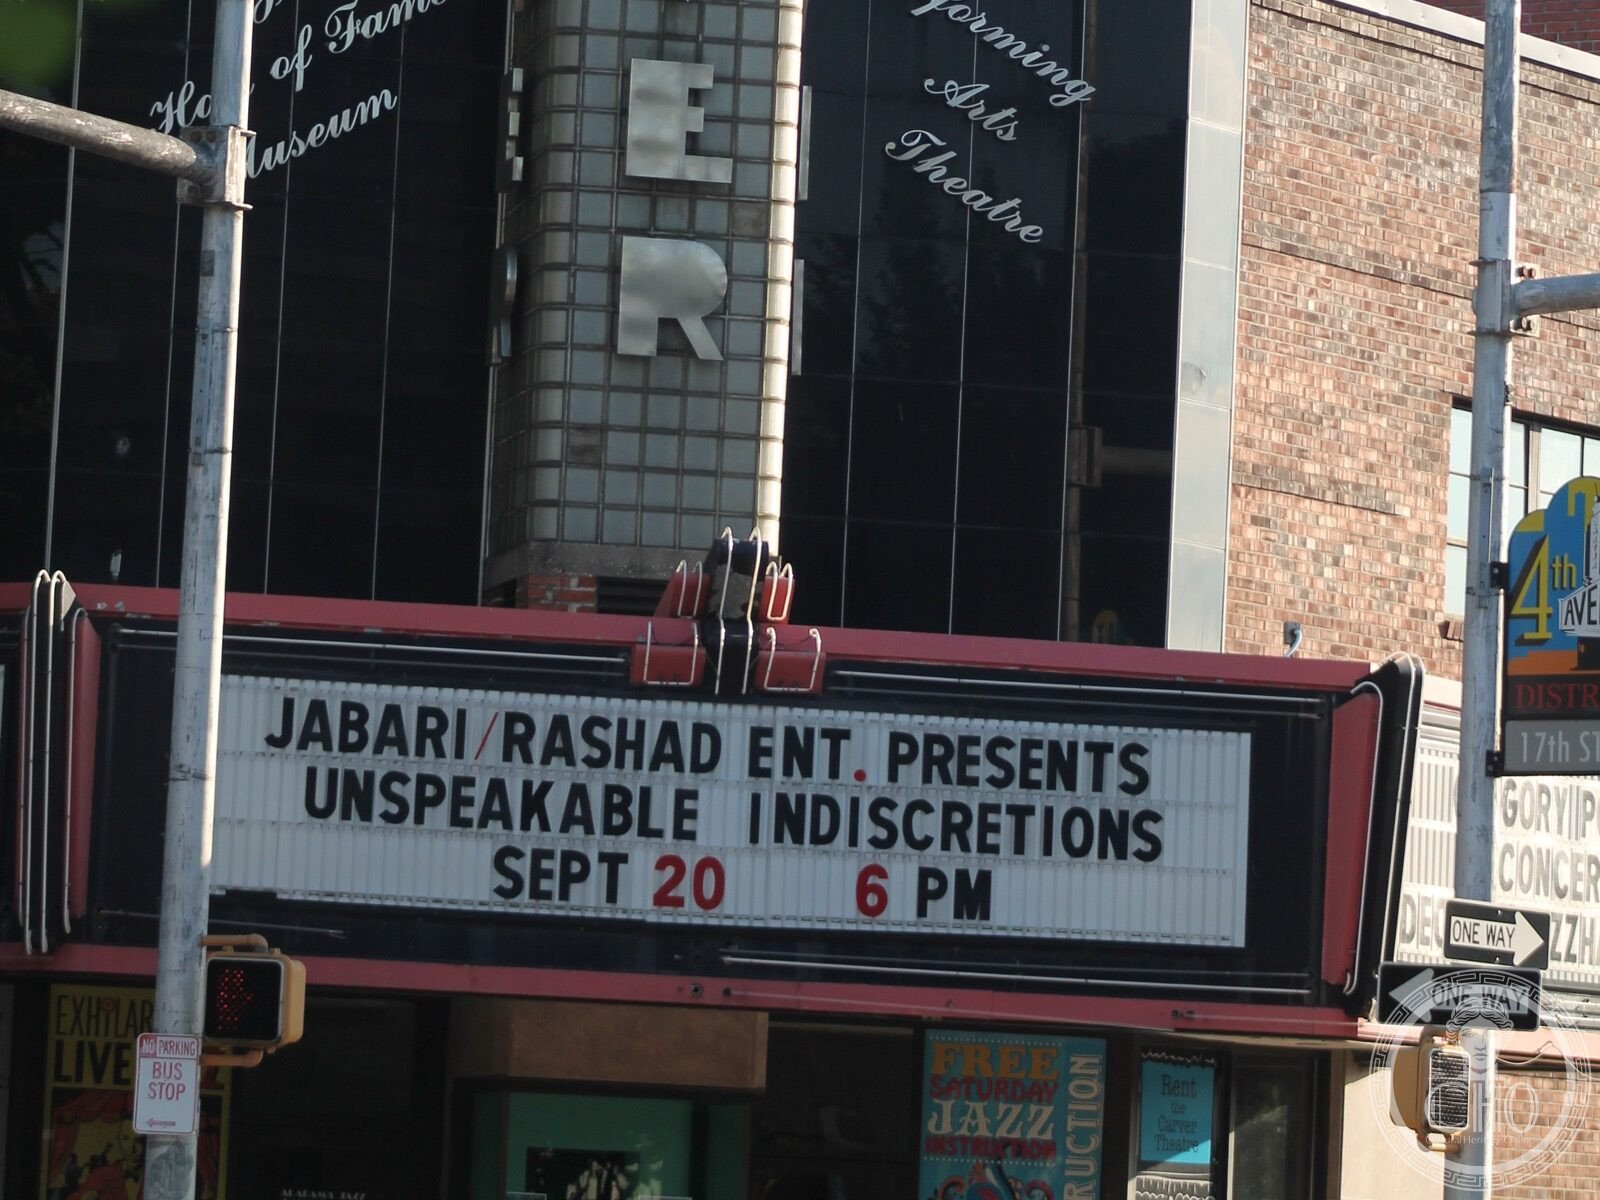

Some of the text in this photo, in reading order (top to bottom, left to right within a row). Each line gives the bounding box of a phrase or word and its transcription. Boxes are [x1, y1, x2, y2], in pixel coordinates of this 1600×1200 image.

[269, 24, 313, 92] of
[924, 78, 1018, 141] Arts
[885, 129, 1043, 243] Theatre
[1511, 534, 1577, 640] 4th
[1563, 584, 1600, 626] AVE
[748, 725, 867, 782] ENT.
[888, 731, 1150, 796] PRESENTS
[1521, 730, 1570, 764] 17th
[304, 765, 1163, 863] UNSPEAKABLE INDISCRETIONS
[493, 845, 992, 922] SEPT 20 6 PM
[1452, 919, 1515, 949] ONE WAY
[56, 994, 154, 1037] EXHILAR
[54, 1040, 132, 1086] LIVE
[141, 1038, 196, 1057] NO PARKING
[931, 1042, 1060, 1081] FREE
[152, 1061, 183, 1081] BUS
[928, 1075, 1059, 1103] SATURDAY
[1161, 1074, 1198, 1098] Rent
[148, 1082, 186, 1101] STOP
[1170, 1101, 1186, 1113] the
[927, 1099, 1055, 1140] JAZZ
[1157, 1116, 1198, 1136] Carver
[924, 1134, 1057, 1161] INSTRUCTION
[1154, 1133, 1199, 1153] Theatre
